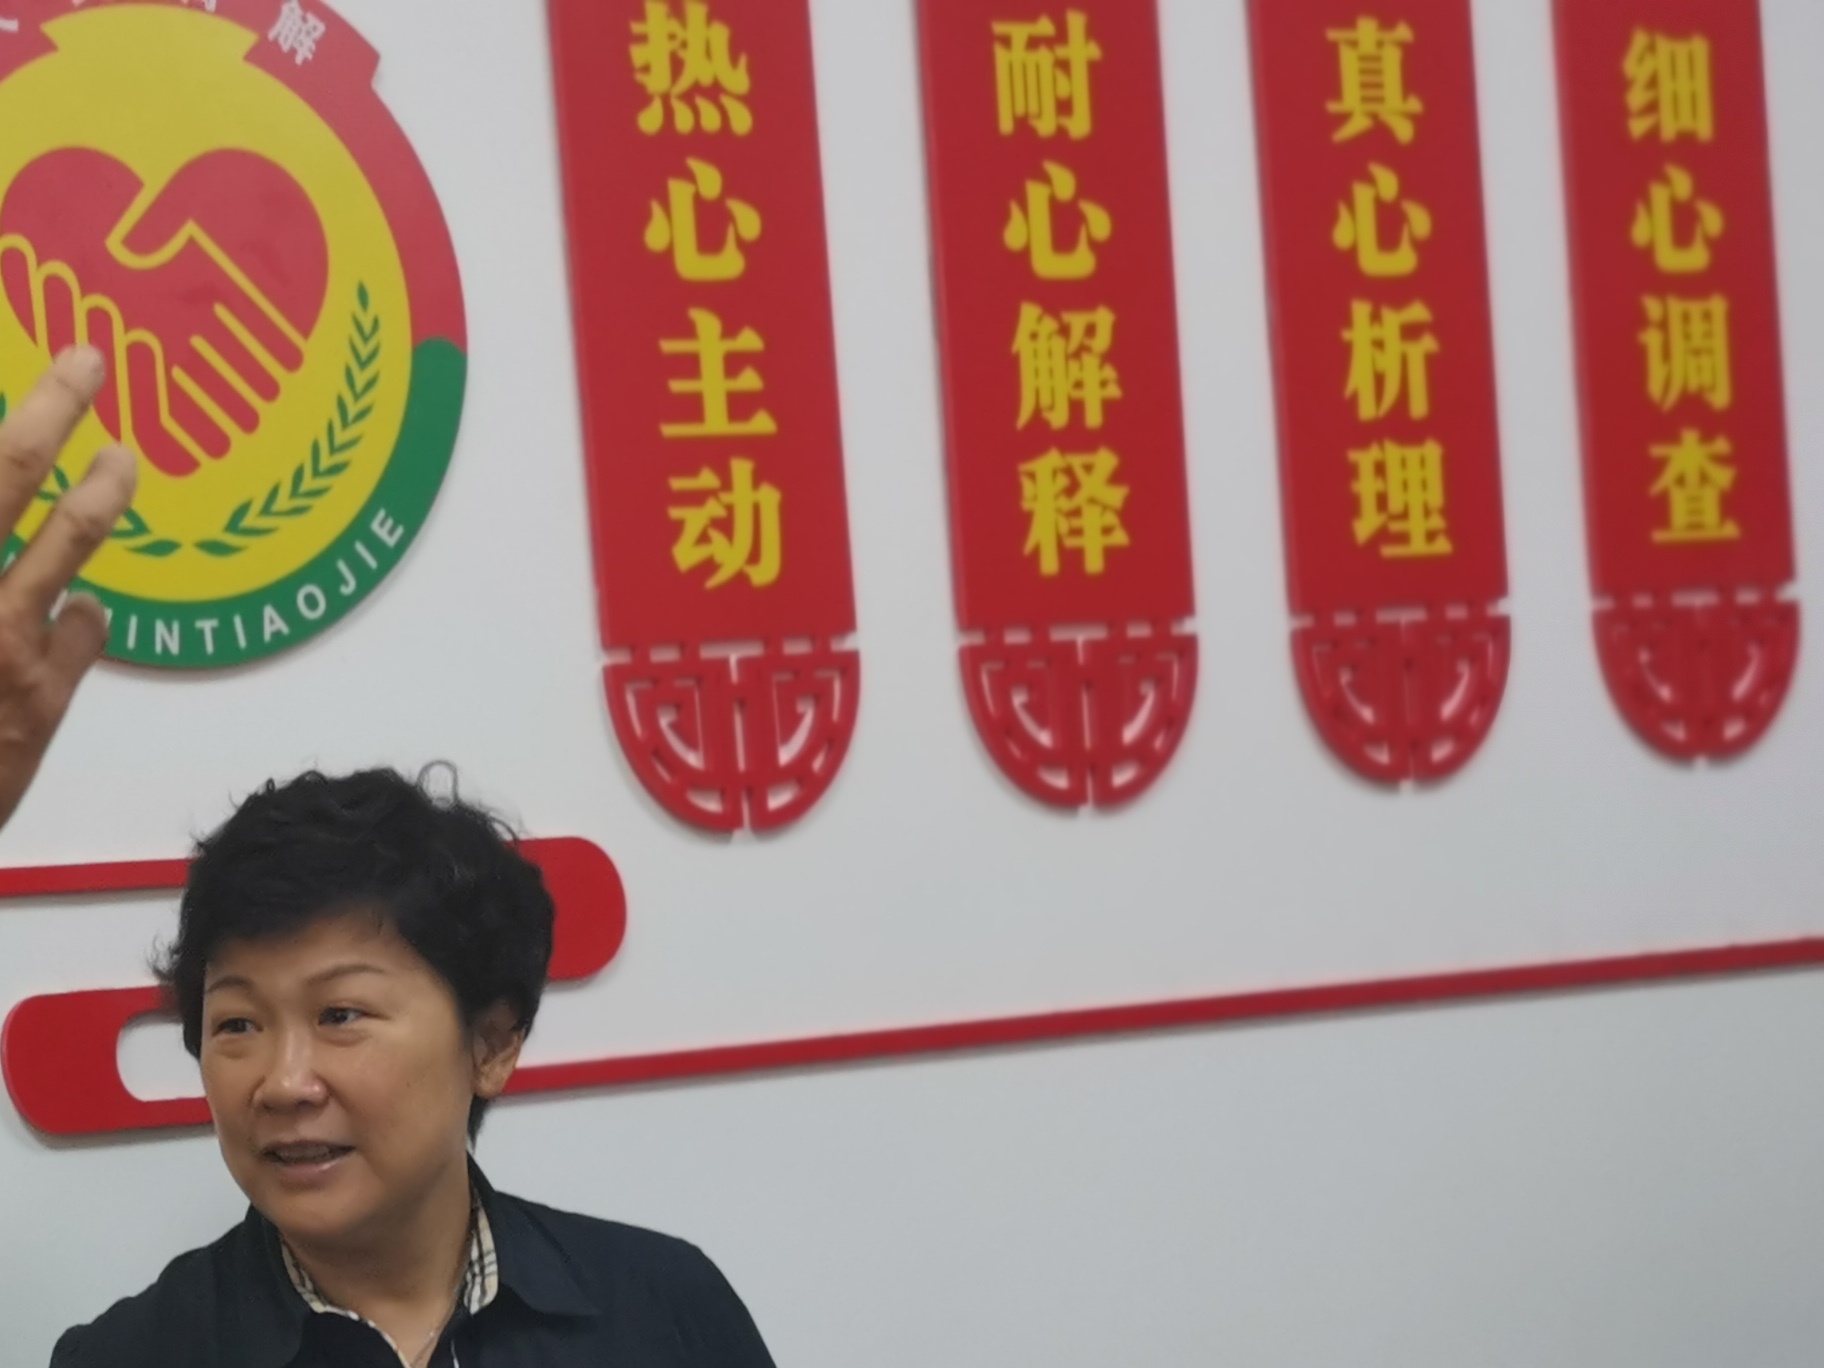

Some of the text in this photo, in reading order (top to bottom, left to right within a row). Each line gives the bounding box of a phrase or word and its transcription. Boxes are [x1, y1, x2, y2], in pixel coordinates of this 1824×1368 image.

[628, 0, 782, 589] 热心主动
[991, 9, 1131, 577] 耐心解释
[1325, 15, 1453, 558] 真心析理
[1622, 28, 1740, 542] 细心调查
